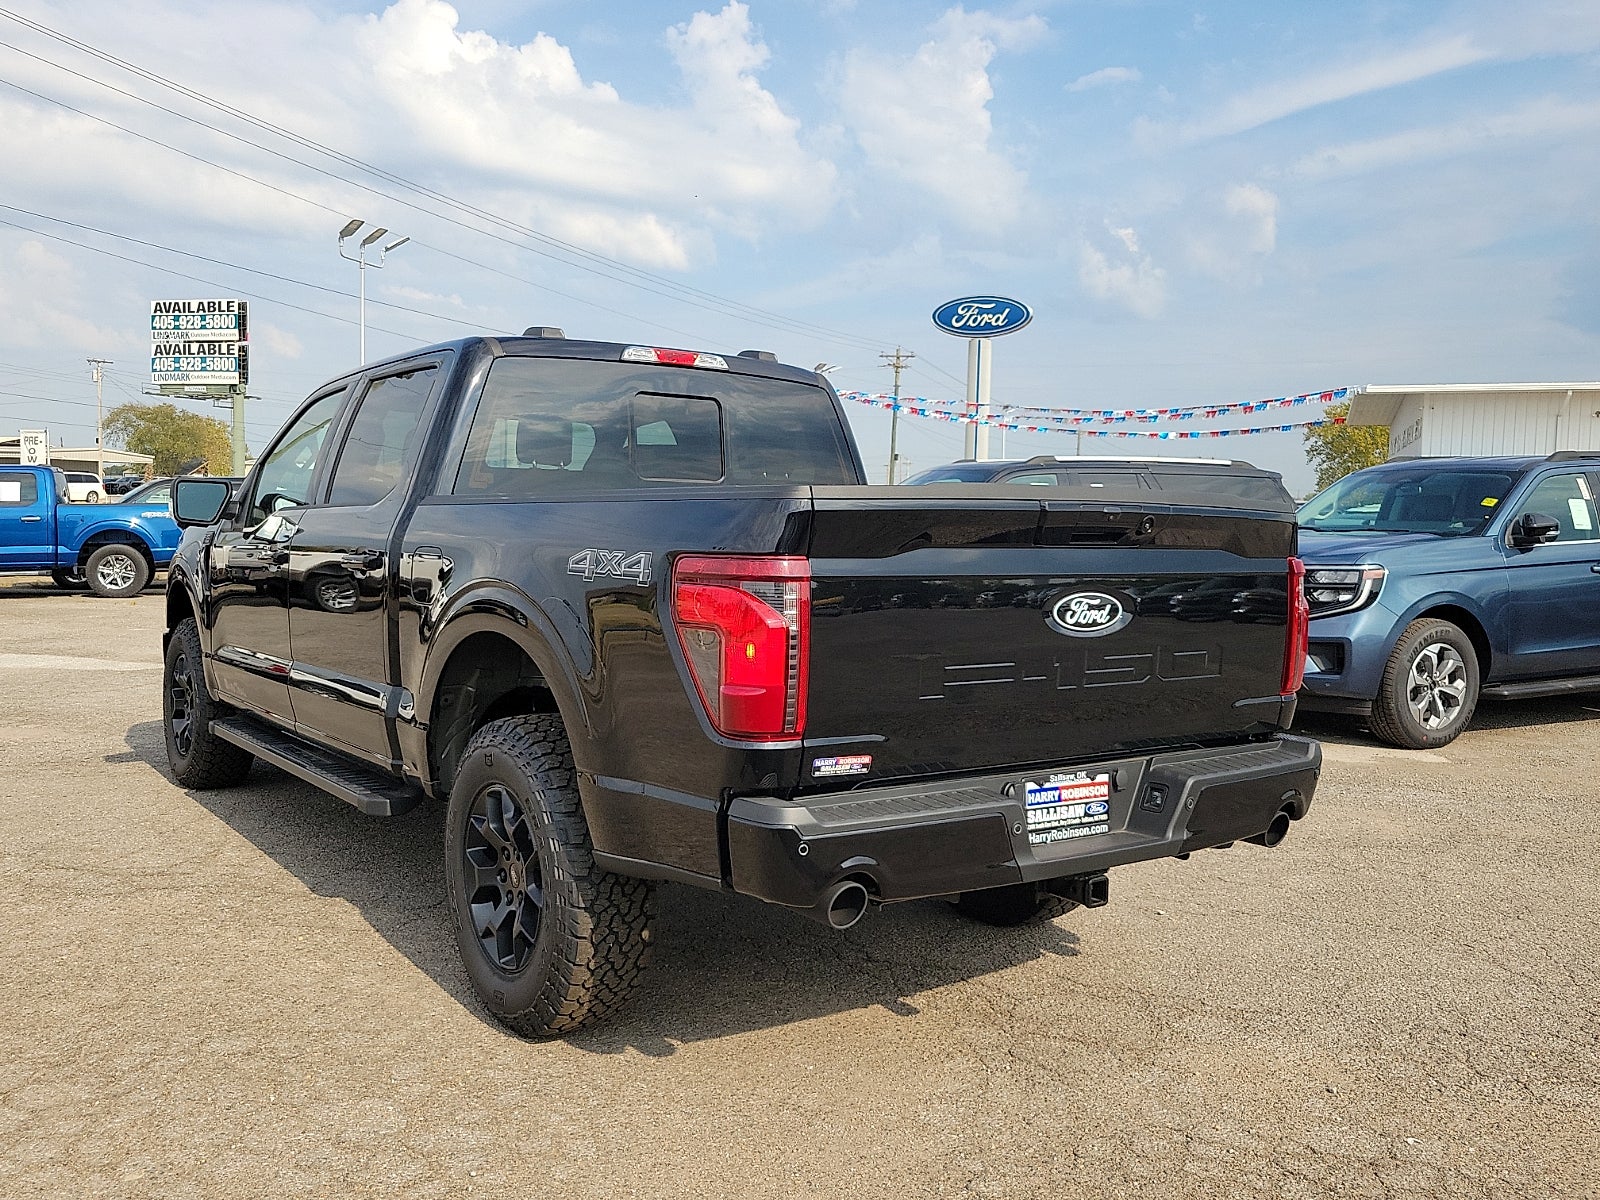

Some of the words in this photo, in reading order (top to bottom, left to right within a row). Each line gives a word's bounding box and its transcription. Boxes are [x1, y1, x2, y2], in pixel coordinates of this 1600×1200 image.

[153, 300, 236, 314] AVAILABLE
[152, 315, 236, 329] 405-928-5800
[951, 303, 1010, 328] Ford
[153, 343, 236, 356] AVAILABLE
[152, 357, 236, 371] 405-928-5800
[153, 373, 191, 382] LINDMARK
[1065, 597, 1112, 625] Ford
[815, 759, 837, 767] HARRY
[1028, 790, 1060, 804] HARRY
[1061, 785, 1108, 800] ROBINSON
[1027, 803, 1086, 824] SALLISAW
[1028, 824, 1109, 844] HarryRobinson.com
